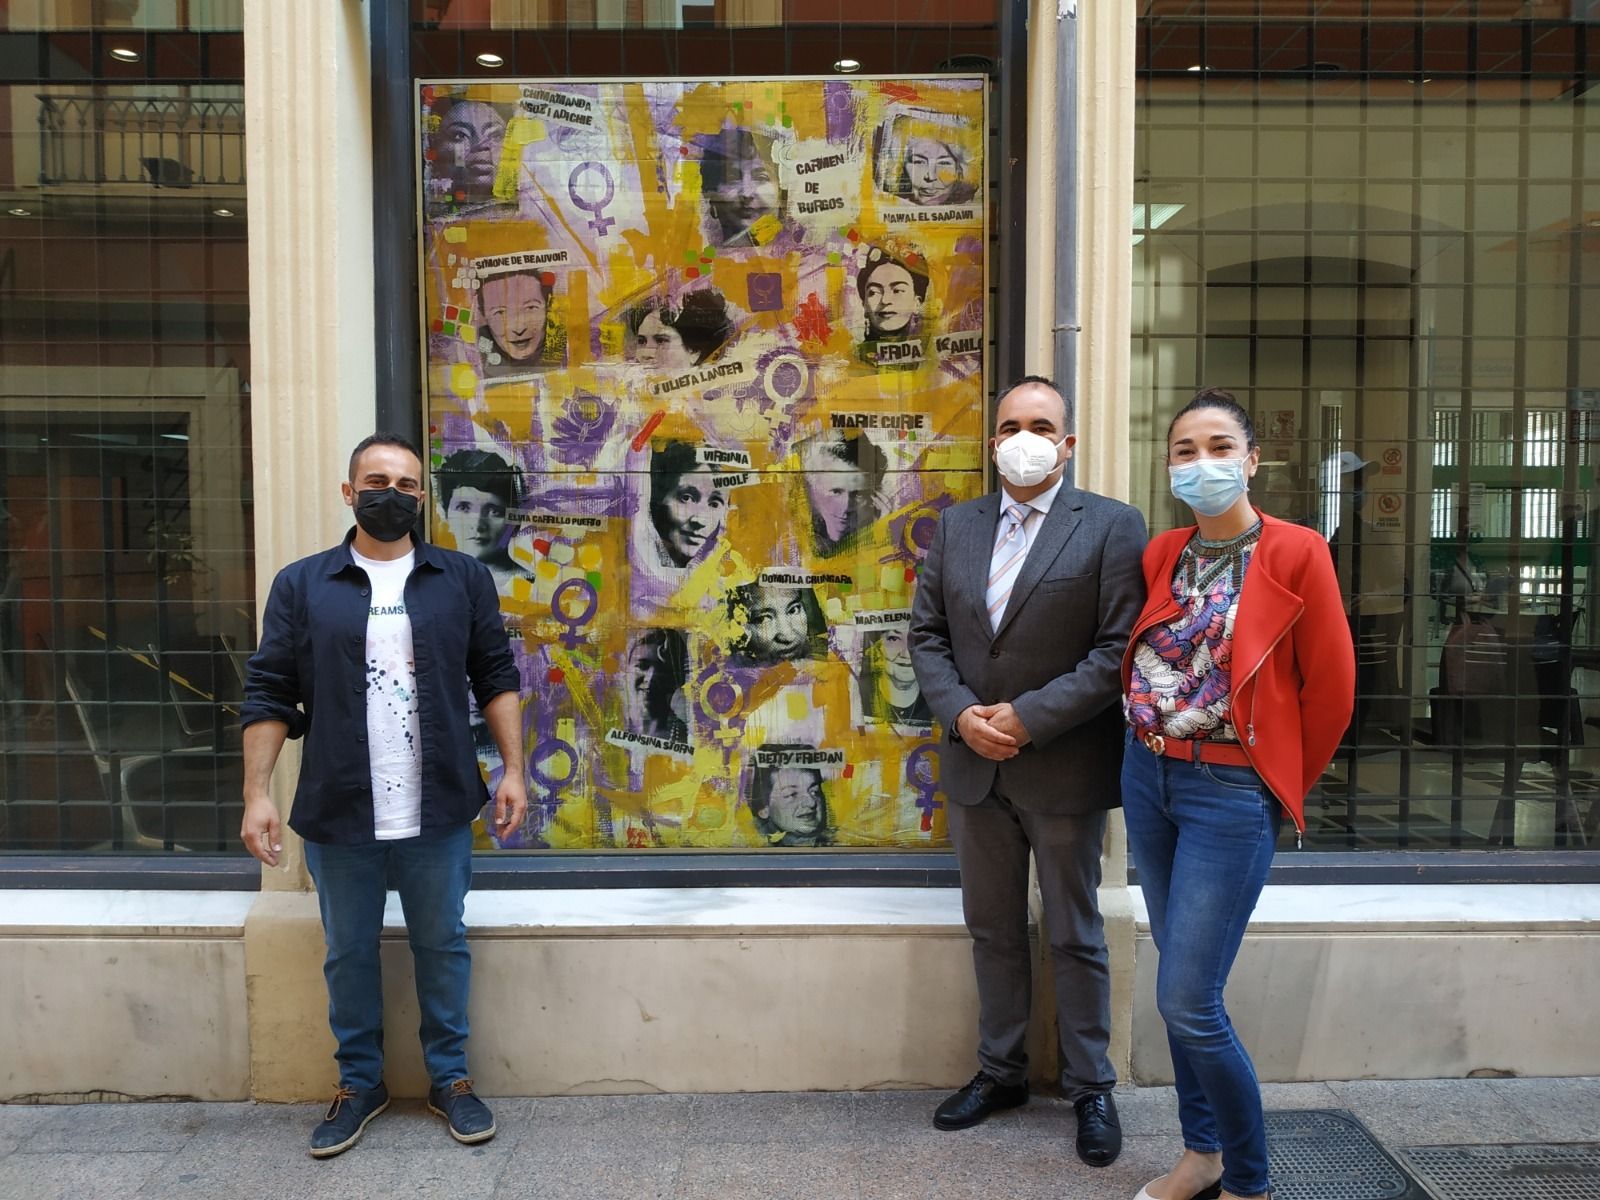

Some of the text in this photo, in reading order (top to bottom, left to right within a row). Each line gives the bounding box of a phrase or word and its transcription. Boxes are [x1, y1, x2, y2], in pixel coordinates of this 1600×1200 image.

[523, 88, 592, 111] CHIMAMANDA
[553, 109, 593, 126] ADICHIE
[796, 153, 845, 175] CARMEN
[805, 182, 819, 194] DE
[797, 197, 845, 214] BURGOS
[883, 210, 973, 223] NAWAL EL SAADAWI
[475, 251, 568, 270] SIMONE DE BEAUVOIR
[879, 343, 921, 361] FRIDA
[703, 450, 749, 465] VIRGINIA
[712, 474, 749, 489] WOOLF
[610, 730, 662, 749] ALFONSINA
